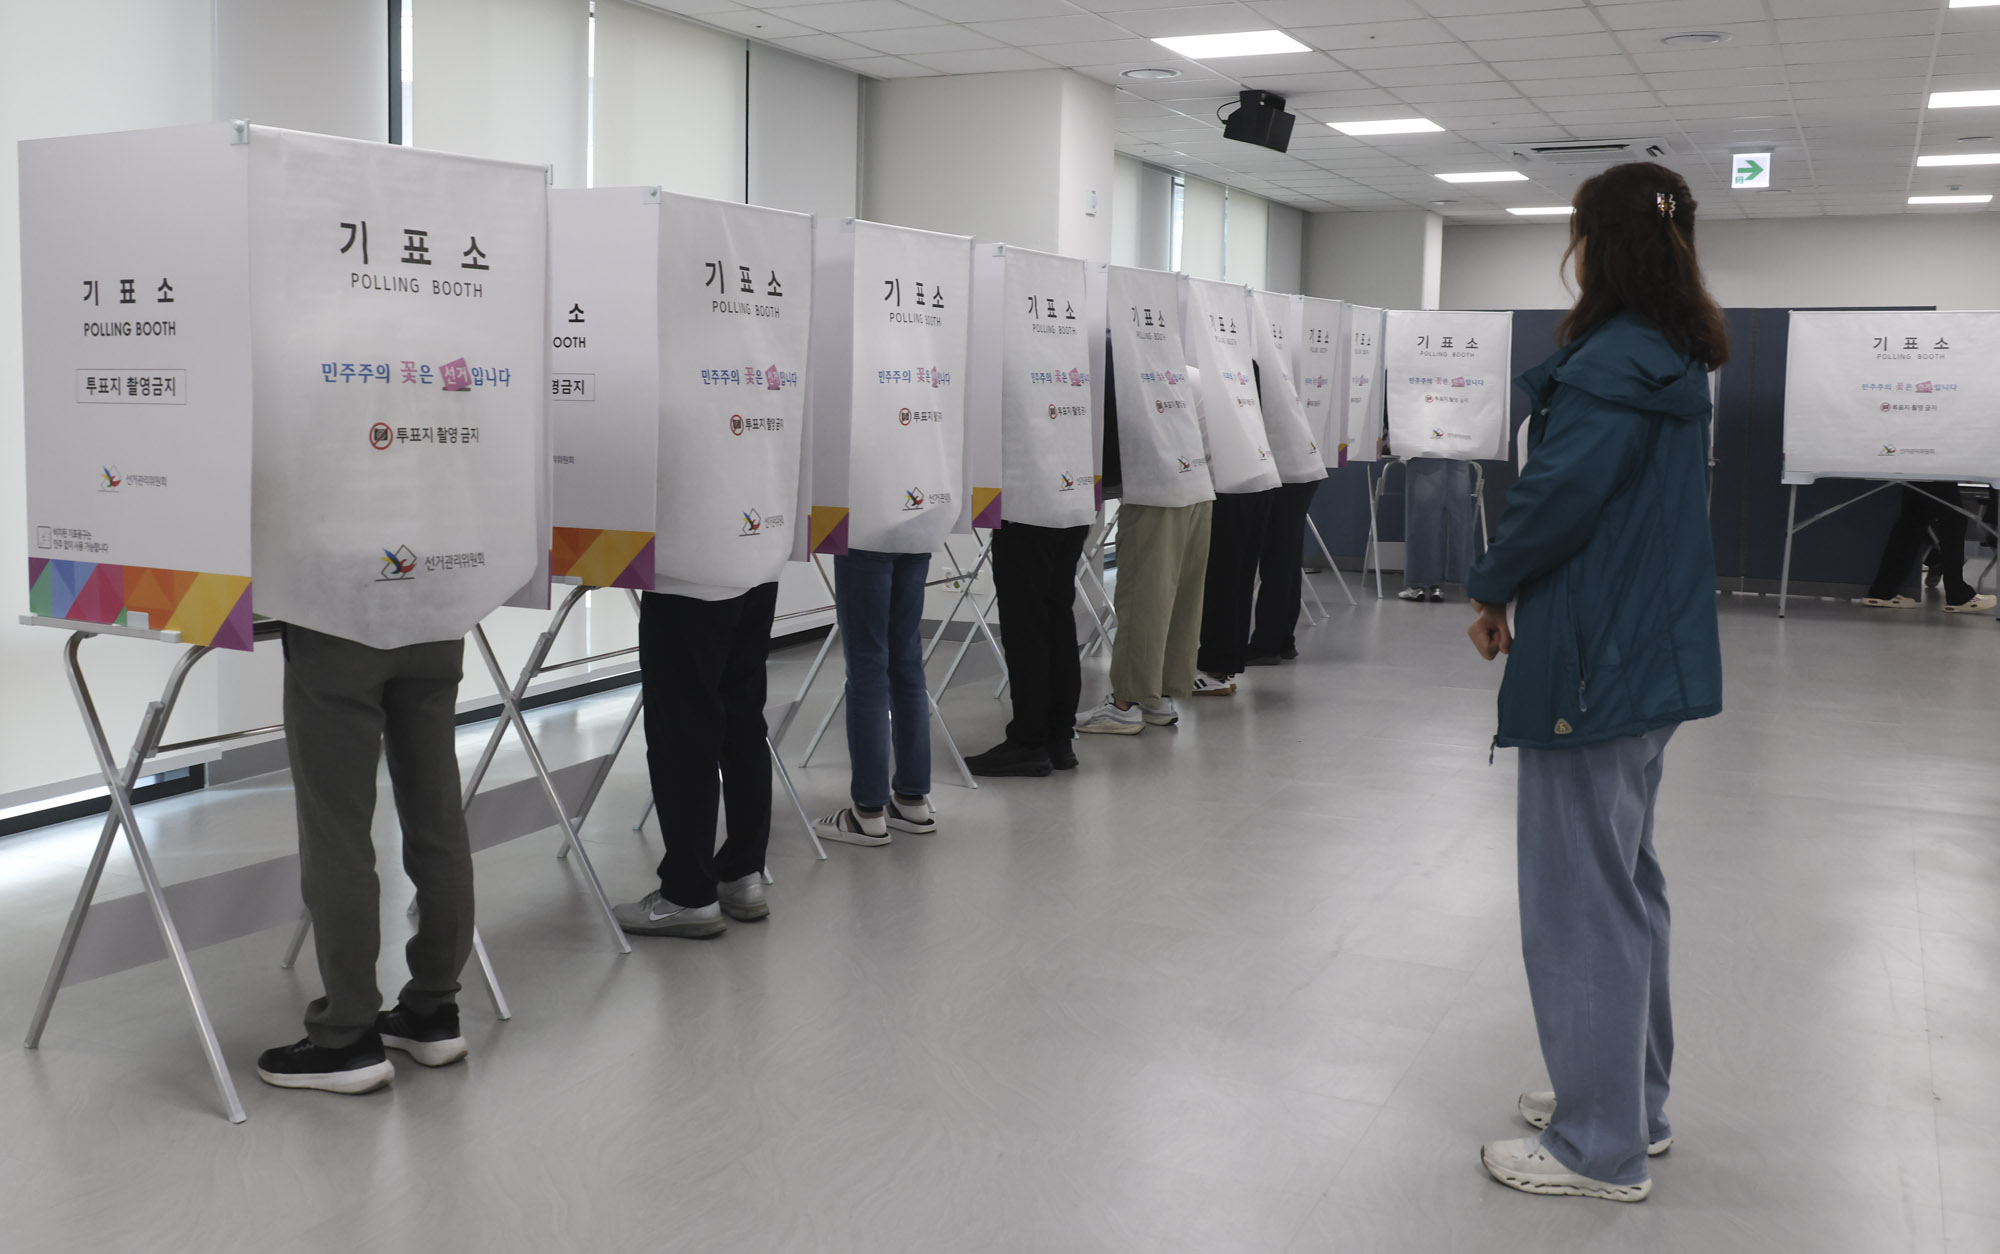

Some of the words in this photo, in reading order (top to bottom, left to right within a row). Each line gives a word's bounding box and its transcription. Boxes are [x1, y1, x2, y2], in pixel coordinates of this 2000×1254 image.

[340, 220, 369, 265] 기
[401, 228, 432, 266] 표
[461, 236, 490, 271] 소
[351, 272, 420, 293] POLLING
[432, 279, 483, 298] BOOTH
[705, 260, 724, 295] 기
[739, 265, 754, 294] 표
[767, 270, 783, 297] 소
[83, 280, 99, 306] 기
[120, 279, 136, 304] 표
[157, 277, 174, 303] 소
[884, 278, 901, 307] 기
[915, 281, 926, 306] 표
[932, 285, 945, 309] 소
[568, 303, 585, 323] 소
[712, 300, 751, 315] POLLING
[755, 304, 780, 318] BOOTH
[889, 312, 923, 324] POLLING
[1046, 298, 1058, 319] 표
[1065, 300, 1077, 320] 소
[84, 321, 132, 336] POLLING
[136, 320, 176, 336] BOOTH
[552, 336, 586, 349] OOTH
[1417, 335, 1429, 349] 기
[1440, 336, 1454, 349] 표
[1465, 337, 1479, 349] 소
[1872, 336, 1888, 352] 기
[1902, 336, 1920, 351] 표
[1933, 336, 1950, 351] 소
[1917, 353, 1945, 361] BOOTH
[320, 362, 391, 385] 민주주의
[400, 361, 434, 384] 꽃은
[701, 368, 740, 385] 민주주의
[744, 367, 763, 385] 꽃은
[878, 369, 911, 384] 민주주의
[86, 376, 121, 396] 투표지
[126, 376, 176, 397] 촬영금지
[745, 418, 766, 431] 투표지
[396, 427, 434, 444] 투표지
[436, 427, 459, 444] 촬영
[460, 427, 480, 443] 금지
[424, 551, 486, 572] 선거관리위원회
